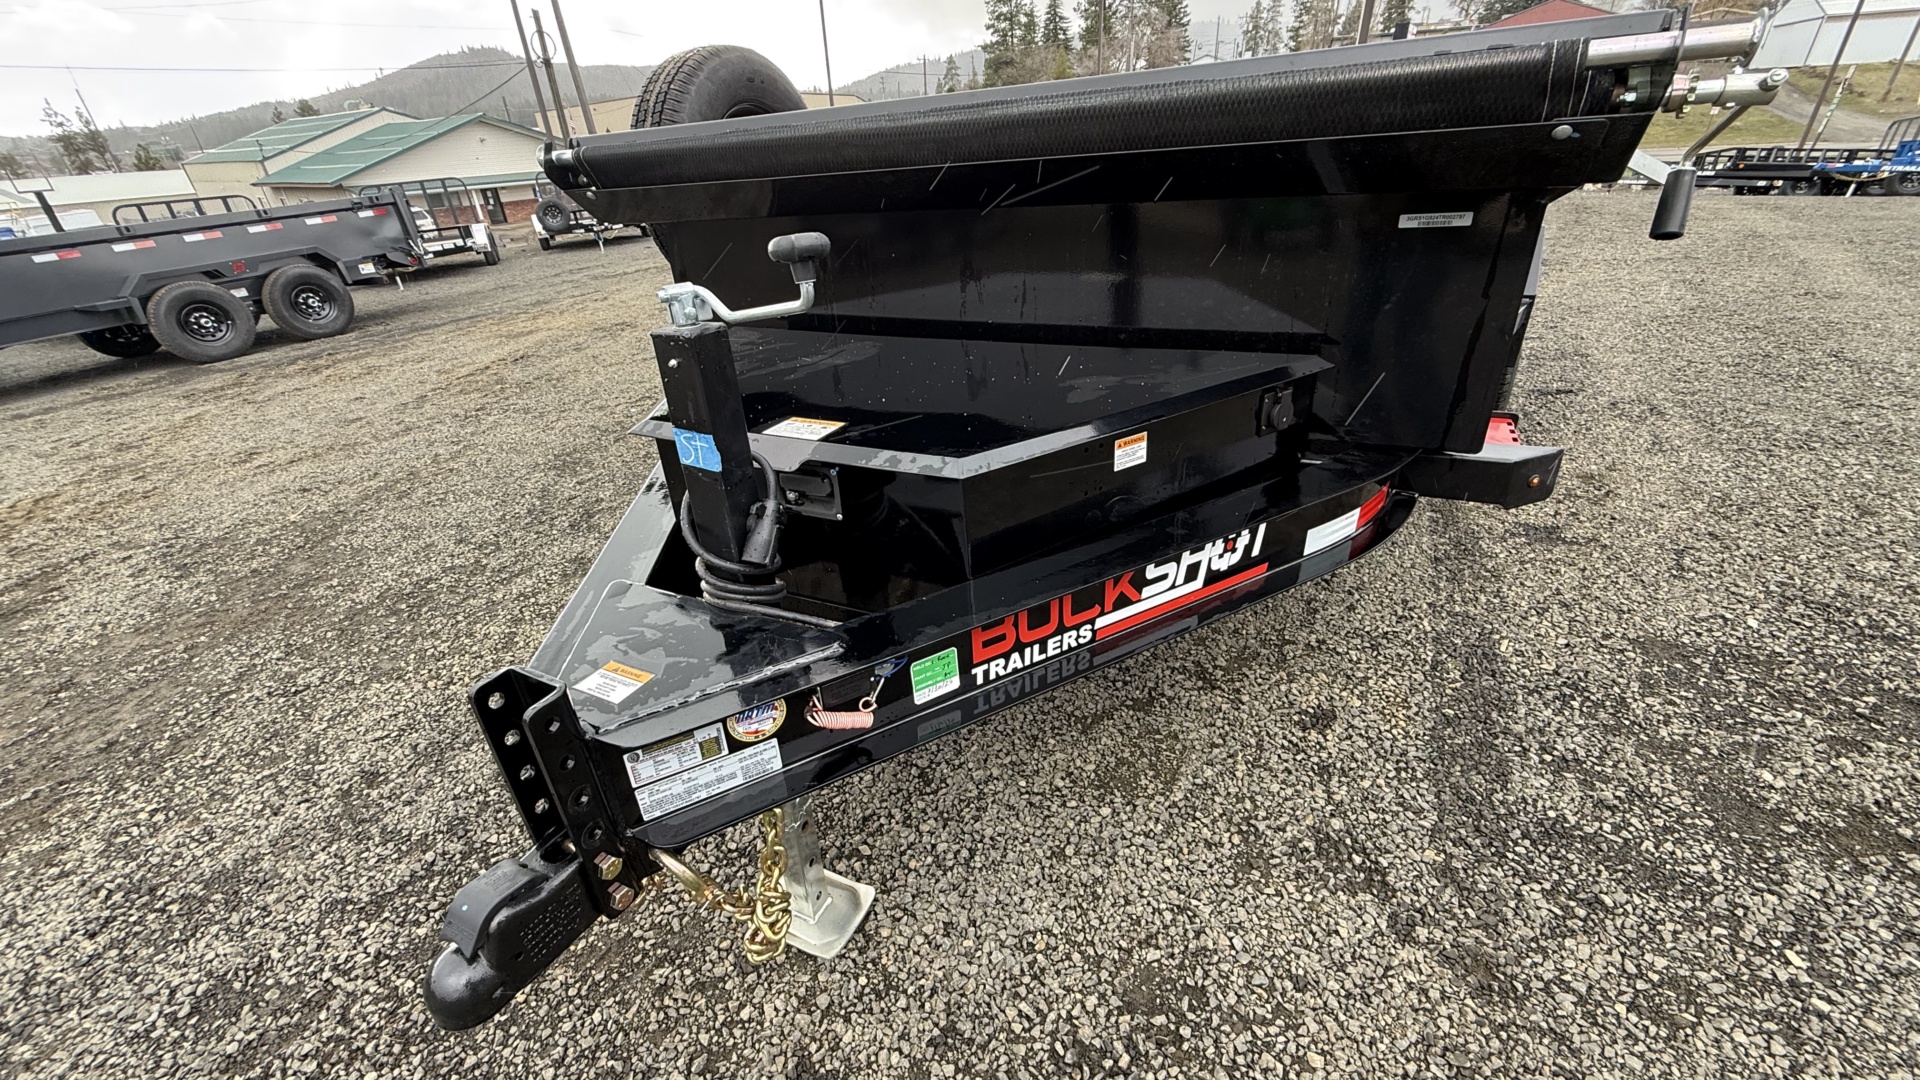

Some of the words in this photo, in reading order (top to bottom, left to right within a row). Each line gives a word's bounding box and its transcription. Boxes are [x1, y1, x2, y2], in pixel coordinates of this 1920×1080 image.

[1406, 213, 1466, 221] 3GRS1G924TR002797
[1123, 435, 1146, 447] WARNING
[971, 624, 1093, 686] TRAILERS
